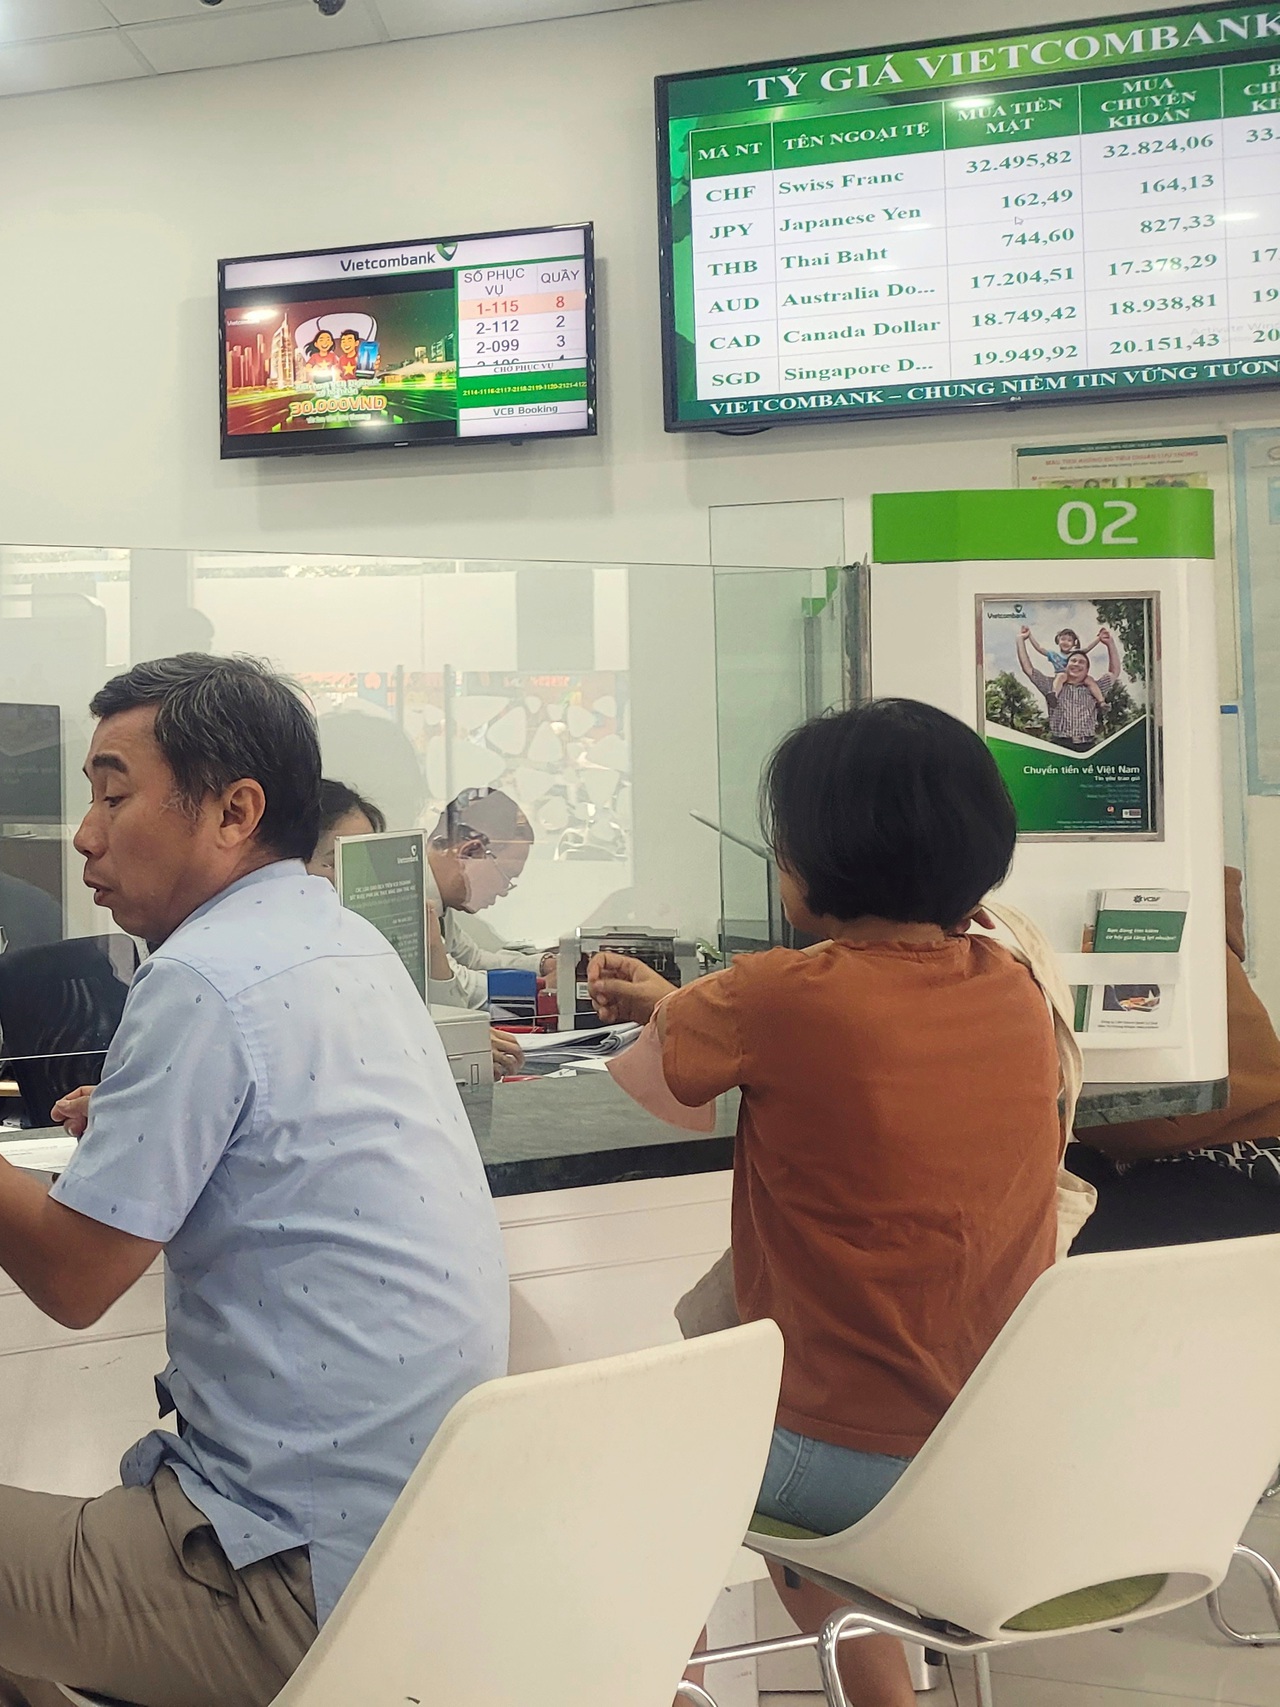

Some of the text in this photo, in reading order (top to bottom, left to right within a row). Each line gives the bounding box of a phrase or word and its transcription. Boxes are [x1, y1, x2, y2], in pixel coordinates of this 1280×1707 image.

[747, 12, 1280, 102] TỶ GIÁ VIETCOMBANK
[1122, 77, 1174, 94] MUA
[958, 105, 1007, 121] MUA
[783, 122, 929, 150] TÊN NGOẠI TỆ
[698, 142, 763, 161] MÃ NT
[706, 134, 1214, 202] CHF Swiss Franc 32.495,82 32.824,06
[709, 174, 1214, 240] JPY Japanese Yen 162,49 164,13
[708, 214, 1215, 277] THB Thai Baht 744,60 827,33
[340, 251, 436, 272] Vietcombank
[464, 267, 525, 284] SỐ PHỤC
[708, 253, 1217, 314] AUD Australia Do... 17.204,51 17.378,29
[485, 284, 504, 296] VỤ
[476, 296, 565, 315] 1-115 8
[476, 315, 565, 335] 2-112 2
[709, 293, 1217, 350] CAD Canada Dollar 18.749,42 18.938,81
[476, 335, 566, 354] 2-099 3
[712, 371, 761, 387] SGD
[784, 363, 891, 382] Singapore
[897, 358, 933, 372] D...
[973, 345, 1078, 366] 19.949,92
[1108, 333, 1221, 355] 20.151,43
[709, 390, 884, 415] VIETCOMBANK
[906, 382, 995, 401] CHUNG
[1073, 371, 1118, 388] TIN
[1204, 360, 1280, 378] TƯƠN
[493, 404, 558, 417] VCB Booking
[1056, 500, 1139, 546] 02
[1096, 764, 1116, 775] Việt
[1118, 765, 1140, 774] Nam
